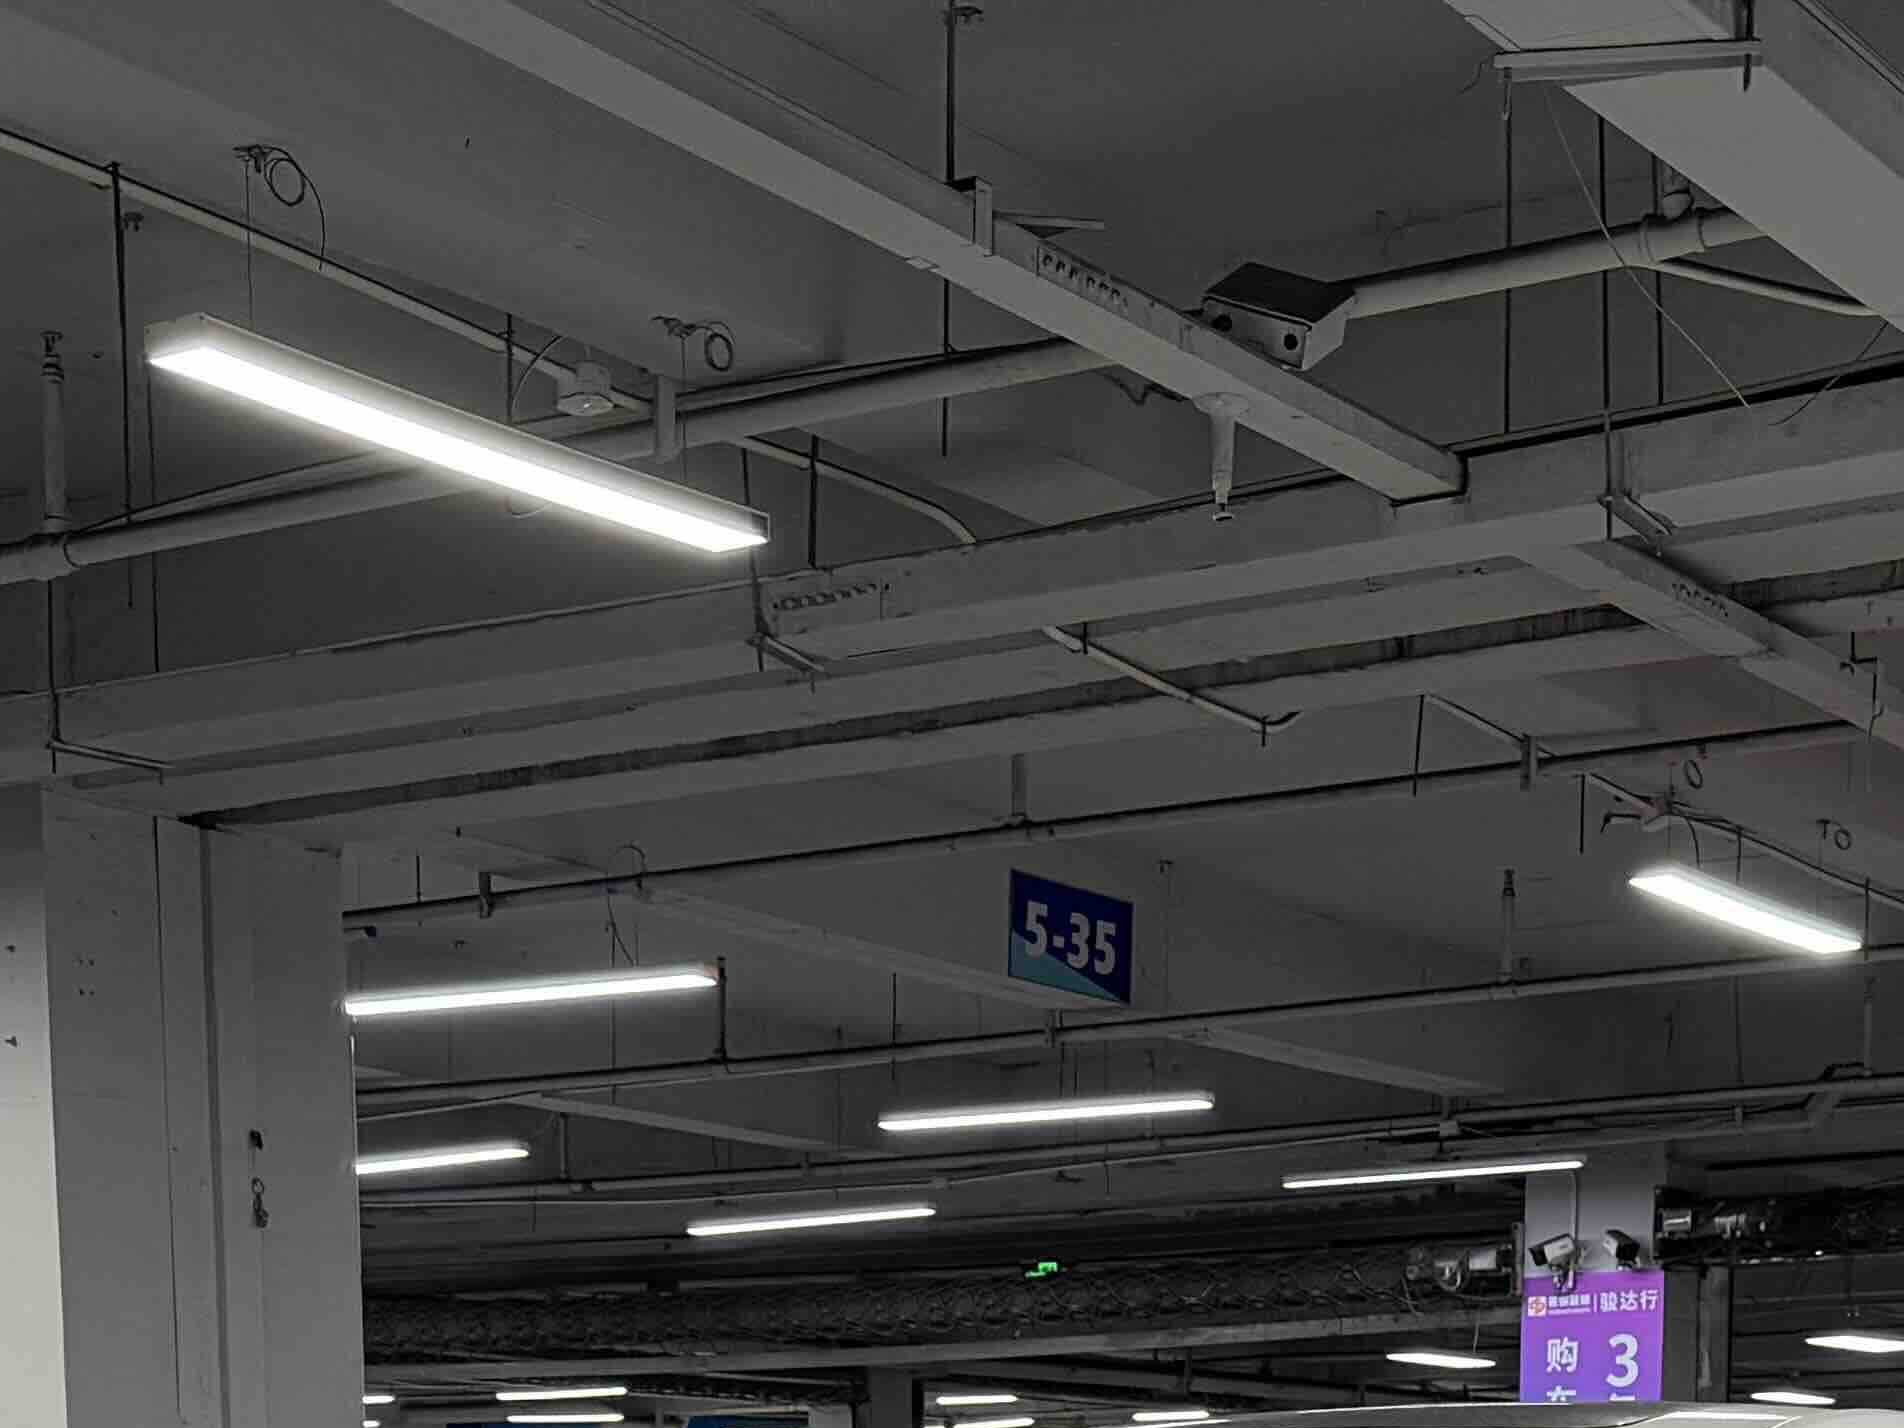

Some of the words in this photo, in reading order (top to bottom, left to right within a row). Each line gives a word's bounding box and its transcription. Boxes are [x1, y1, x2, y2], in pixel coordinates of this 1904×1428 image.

[1024, 900, 1116, 975] 5-35
[1600, 1289, 1658, 1312] 骏达行
